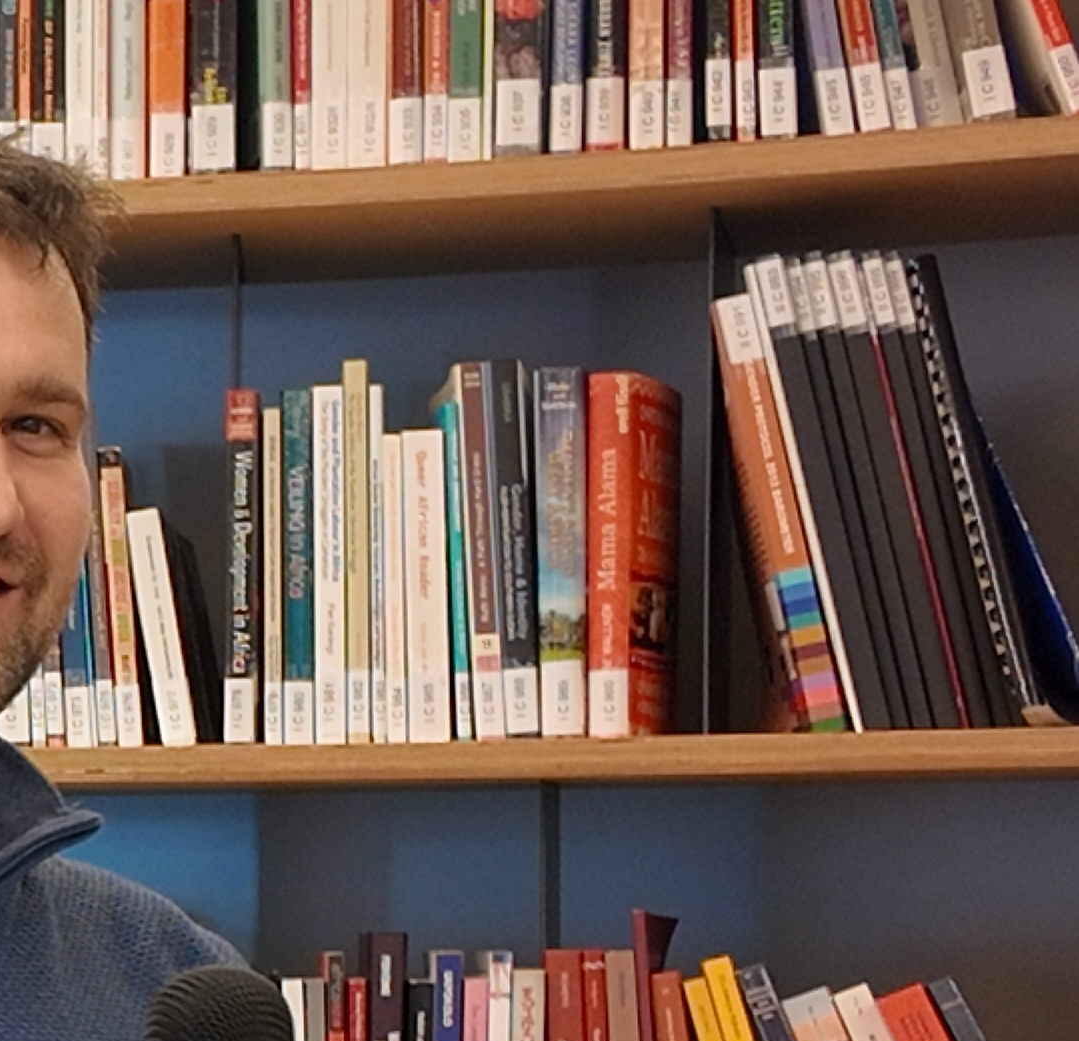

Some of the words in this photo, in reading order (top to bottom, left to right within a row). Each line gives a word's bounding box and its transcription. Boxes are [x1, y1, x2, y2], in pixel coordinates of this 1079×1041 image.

[330, 399, 342, 443] Gender
[232, 450, 254, 505] Women
[596, 447, 617, 517] Alama
[416, 496, 431, 548] African
[231, 521, 254, 612] Development
[287, 554, 308, 599] Africa
[330, 554, 342, 583] Africa
[419, 554, 432, 600] Reader
[597, 522, 617, 592] Mama
[233, 614, 253, 628] in
[231, 631, 254, 674] Africa
